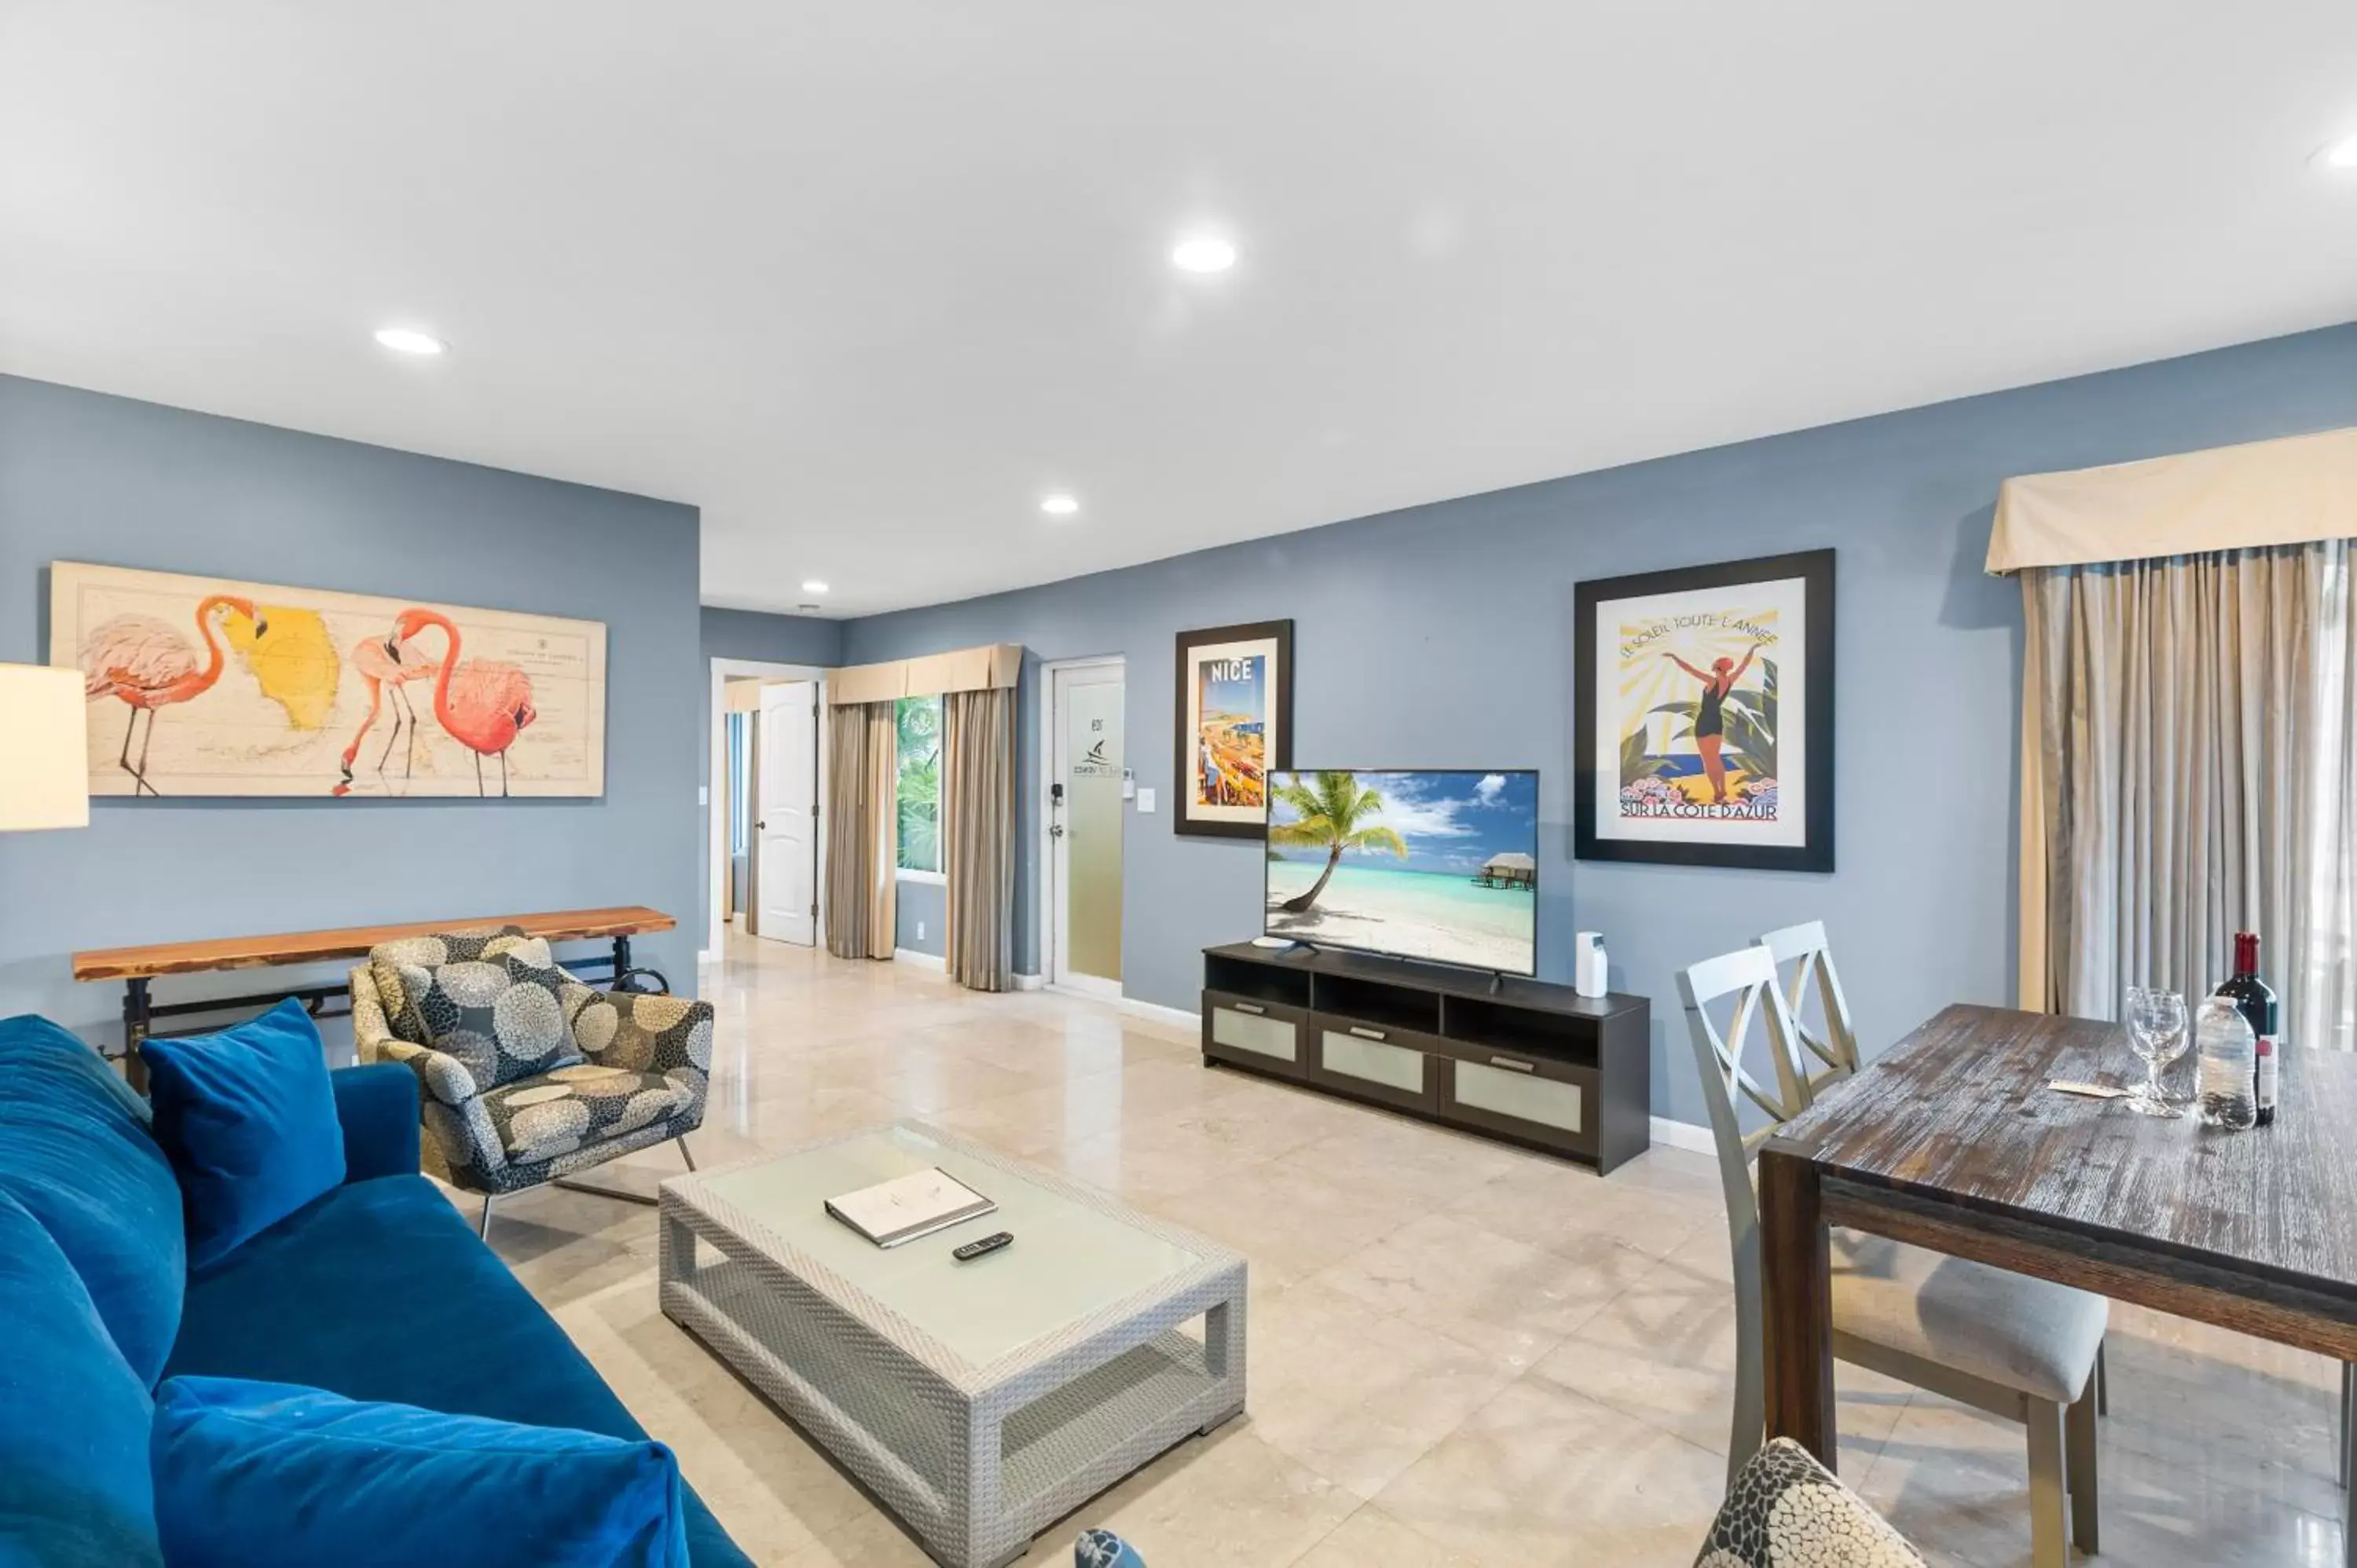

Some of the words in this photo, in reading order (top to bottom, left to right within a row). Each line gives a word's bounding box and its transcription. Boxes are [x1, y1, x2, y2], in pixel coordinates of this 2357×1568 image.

[1633, 625, 1671, 648] SOLEIL
[1673, 614, 1717, 628] TOUTE
[1211, 659, 1252, 683] NICE
[1621, 802, 1649, 817] SUR
[1653, 803, 1671, 817] LA
[1721, 803, 1778, 821] D'AZUR
